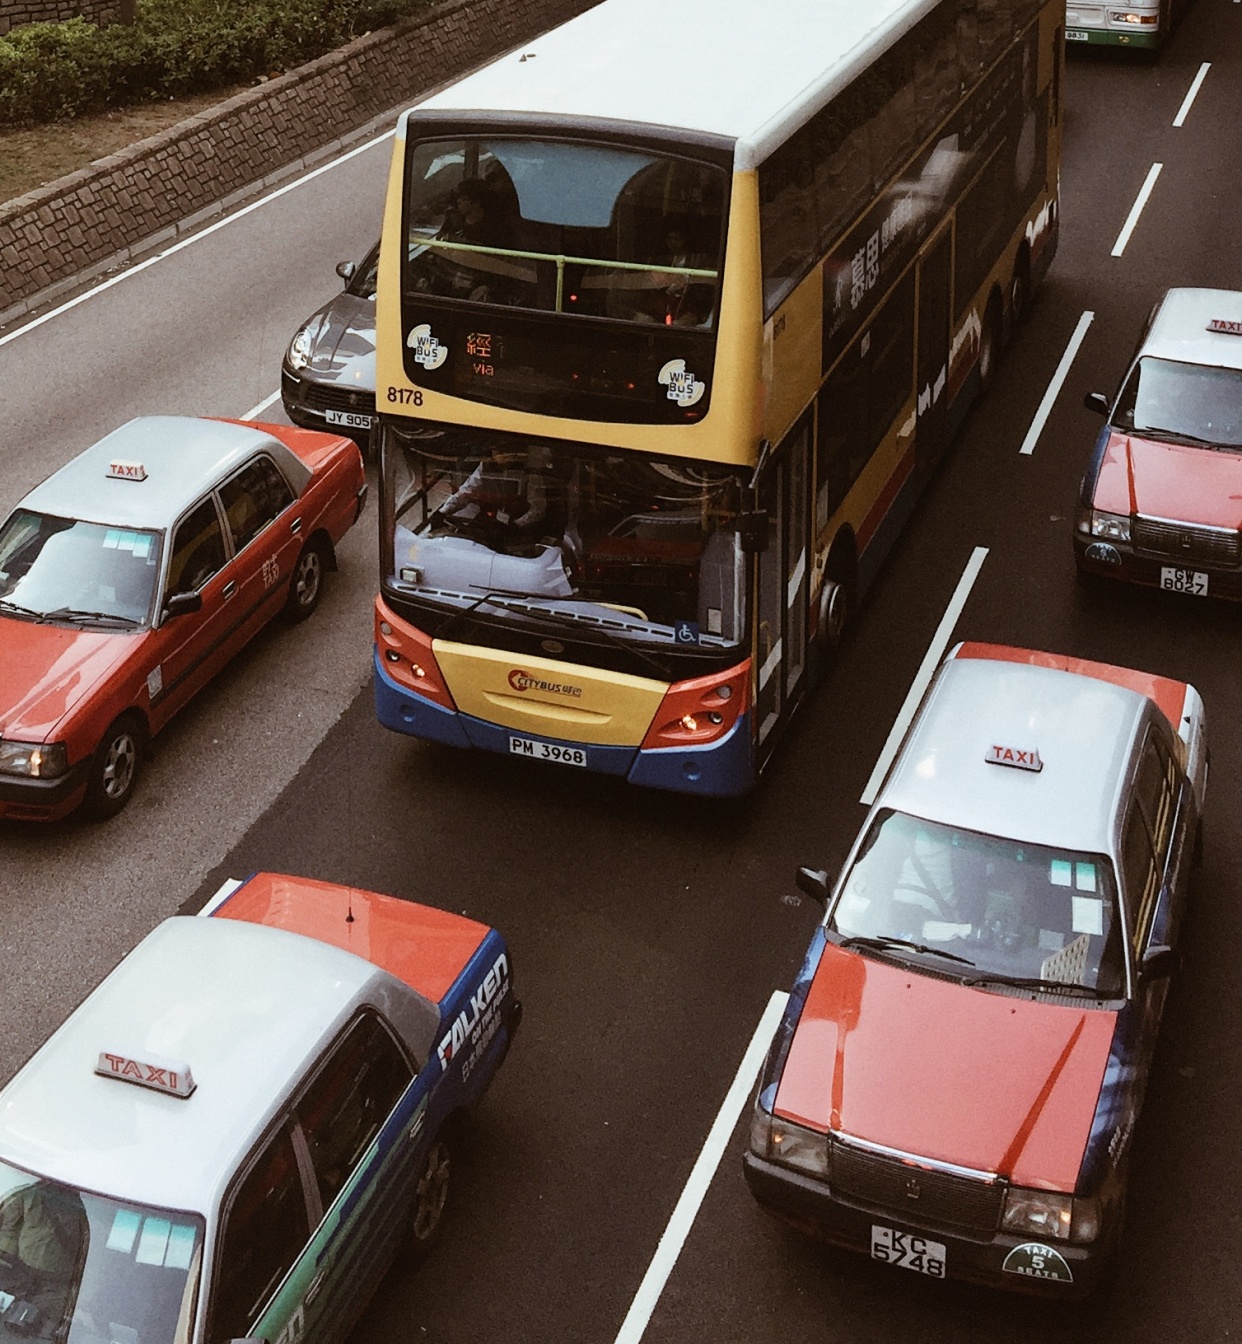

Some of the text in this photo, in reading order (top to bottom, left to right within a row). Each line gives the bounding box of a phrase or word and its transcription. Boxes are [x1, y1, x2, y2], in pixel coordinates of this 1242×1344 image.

[416, 336, 439, 348] WIFI
[416, 346, 438, 358] BUS
[473, 360, 494, 376] via
[669, 372, 694, 384] WIFI
[669, 382, 694, 394] BUS
[387, 386, 424, 407] 8178
[329, 412, 343, 423] JY
[110, 464, 138, 477] TAXI
[263, 566, 280, 589] TAXI
[1175, 569, 1195, 583] GW
[1164, 578, 1205, 595] 8027
[517, 677, 561, 693] CITYBUS
[512, 739, 584, 764] PM 3968
[993, 745, 1035, 765] TAXI
[105, 1053, 177, 1089] TAXI
[891, 1231, 927, 1256] KC
[873, 1241, 943, 1278] 5748
[1023, 1246, 1054, 1258] TAXI
[1031, 1256, 1045, 1268] 5
[1017, 1266, 1059, 1280] SEATS
